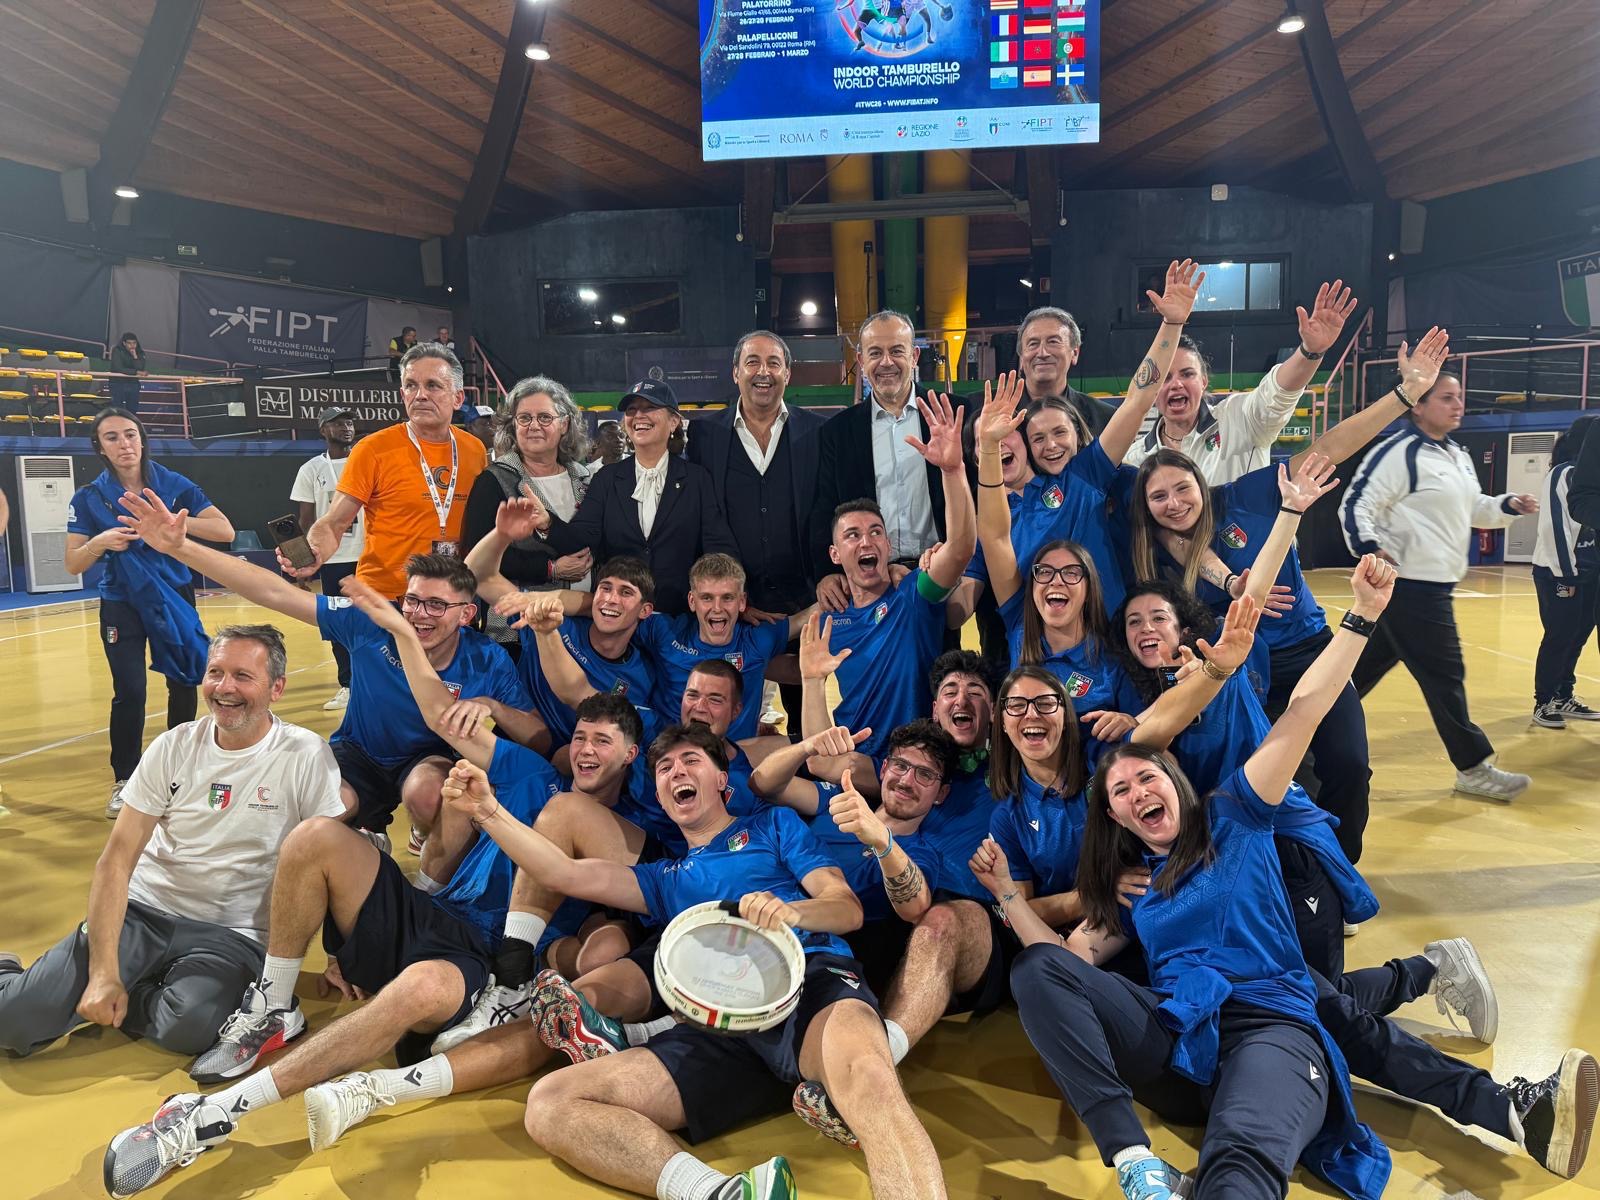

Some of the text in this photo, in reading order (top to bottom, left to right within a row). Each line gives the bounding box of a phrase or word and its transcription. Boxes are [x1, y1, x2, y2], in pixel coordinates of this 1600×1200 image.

[742, 0, 791, 9] PALATORRINO
[765, 15, 794, 24] FEBBRAIO
[737, 31, 798, 42] PALAPELLICONE
[745, 50, 776, 59] FEBBRAIO
[786, 49, 809, 57] MARZO
[833, 61, 960, 78] INDOOR TAMBURELLO
[833, 73, 960, 90] WORLD CHAMPIONSHIP
[911, 123, 939, 131] REGIONE
[1030, 118, 1053, 127] FIPT
[780, 133, 814, 144] ROMA
[249, 305, 338, 343] FIPT
[247, 337, 336, 354] FEDERAZIONE ITALIANA
[253, 345, 330, 360] PALLA TAMBURELLO
[300, 387, 402, 405] DISTILLERI
[300, 406, 401, 421] MAADRO
[832, 617, 852, 626] acron
